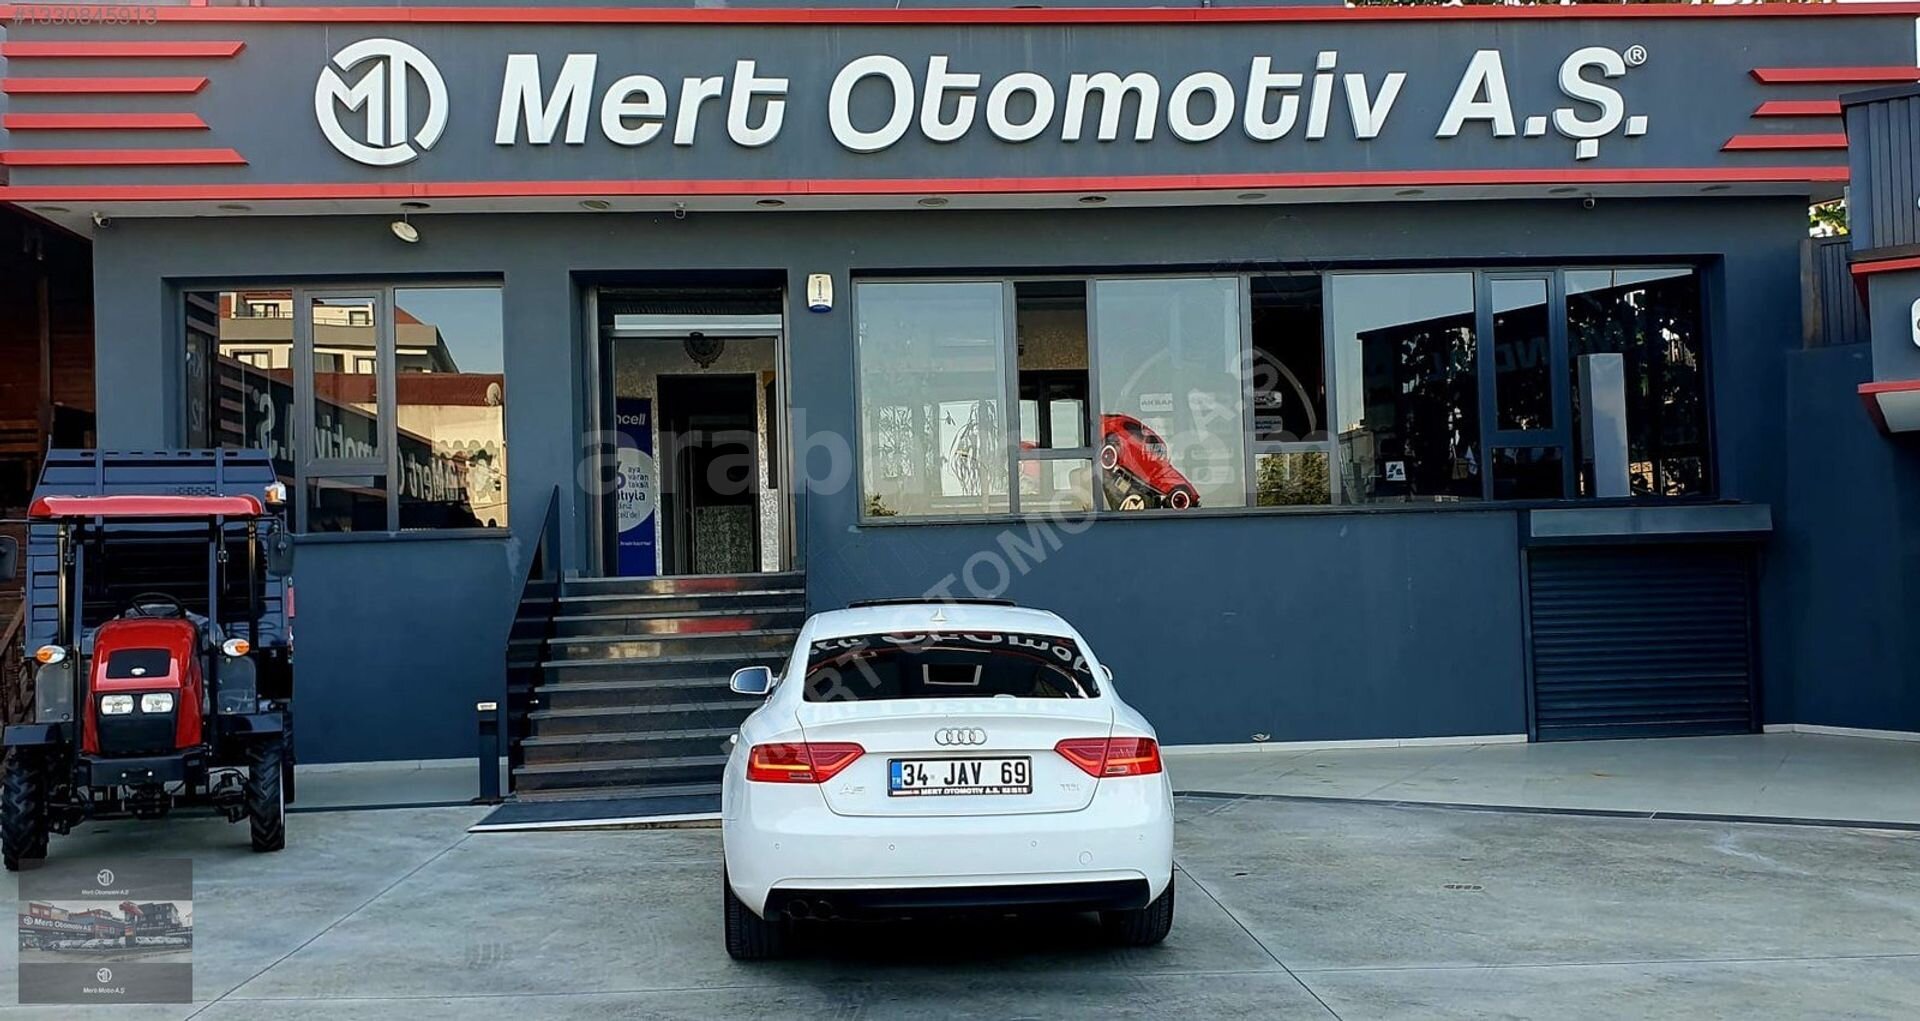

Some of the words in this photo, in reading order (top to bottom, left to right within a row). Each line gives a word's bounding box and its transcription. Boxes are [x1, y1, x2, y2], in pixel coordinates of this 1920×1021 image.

[494, 52, 789, 148] Mert
[827, 49, 1407, 154] Otomotiv
[903, 763, 928, 786] 34
[944, 762, 982, 785] JAV
[1001, 762, 1026, 784] 69
[921, 788, 942, 796] MERT
